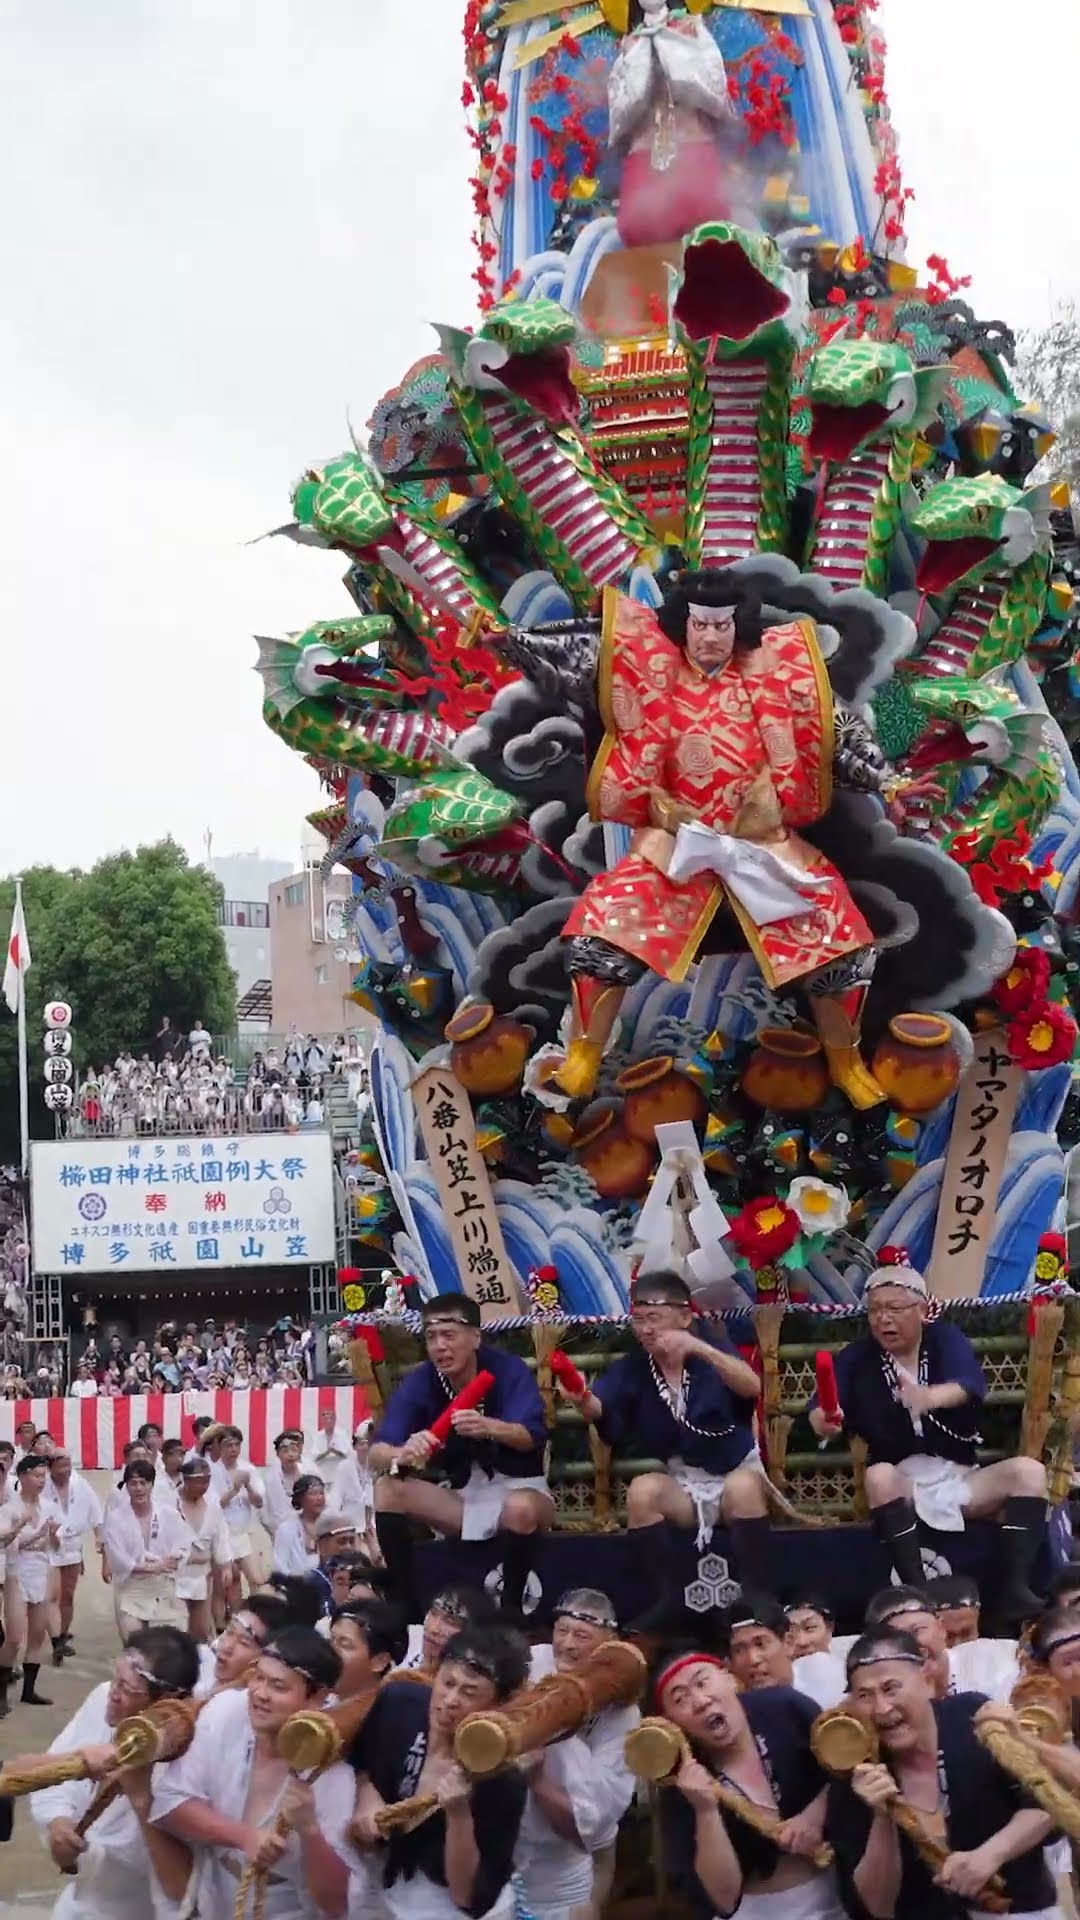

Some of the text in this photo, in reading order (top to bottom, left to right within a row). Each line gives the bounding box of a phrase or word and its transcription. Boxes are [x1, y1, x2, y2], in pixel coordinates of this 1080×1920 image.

[948, 1046, 1014, 1255] ヤマタノオロチ
[59, 1157, 307, 1188] 櫛田神社祇園例大祭
[145, 1190, 227, 1214] 奉納
[427, 1081, 511, 1305] 八番山笠上川端通
[60, 1234, 309, 1266] 博多祇園山笠
